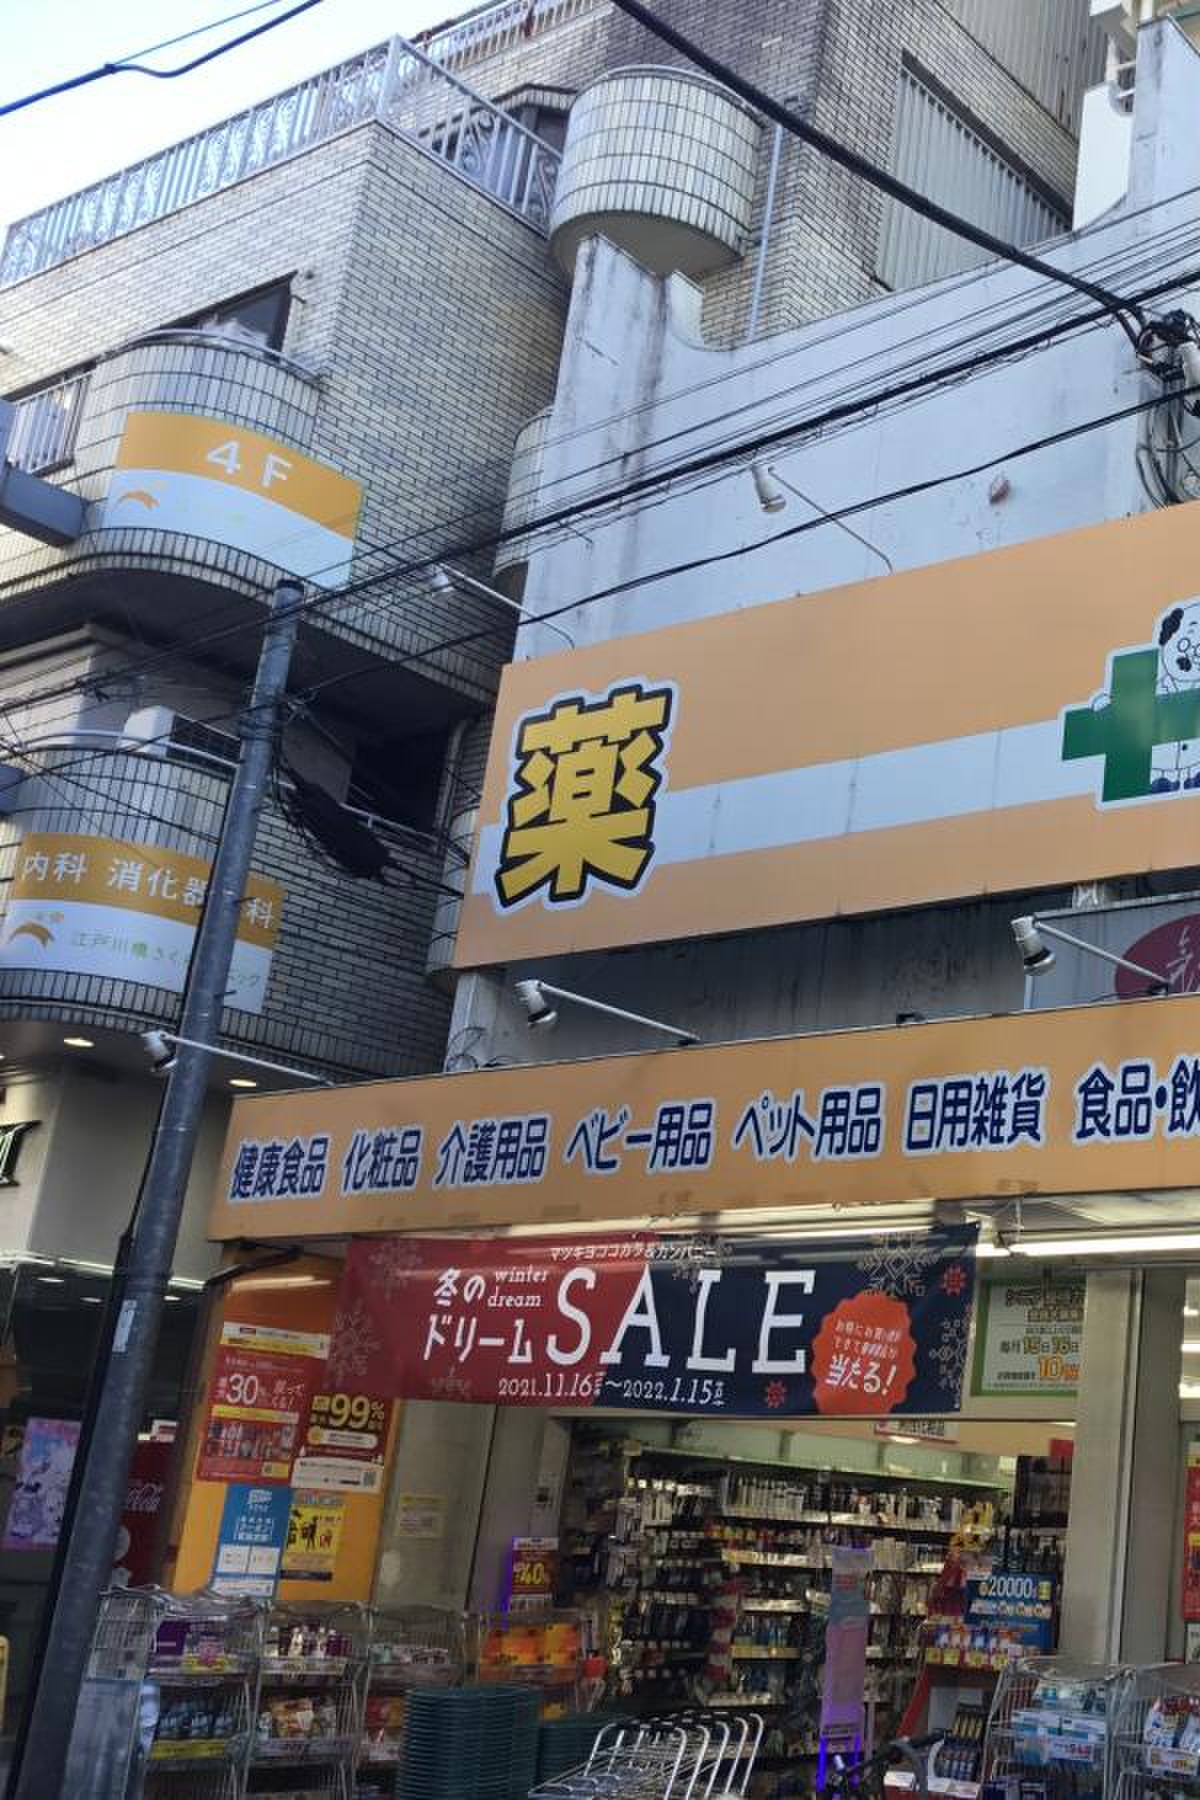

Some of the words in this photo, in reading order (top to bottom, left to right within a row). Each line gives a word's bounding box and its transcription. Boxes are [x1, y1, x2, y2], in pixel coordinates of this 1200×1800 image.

[496, 684, 672, 906] 薬
[22, 852, 87, 884] 内科
[230, 1136, 328, 1199] 健康食品
[343, 1129, 421, 1191] 化粧品
[434, 1117, 549, 1185] 介護用品
[566, 1102, 713, 1169] ベビー用品
[735, 1087, 881, 1157] ペット用品
[906, 1073, 1047, 1151] 日用雑貨
[433, 1267, 487, 1307] 冬の
[495, 1263, 549, 1284] winter
[487, 1285, 542, 1308] dream
[546, 1263, 816, 1375] SALE
[423, 1313, 533, 1363] ドリーム
